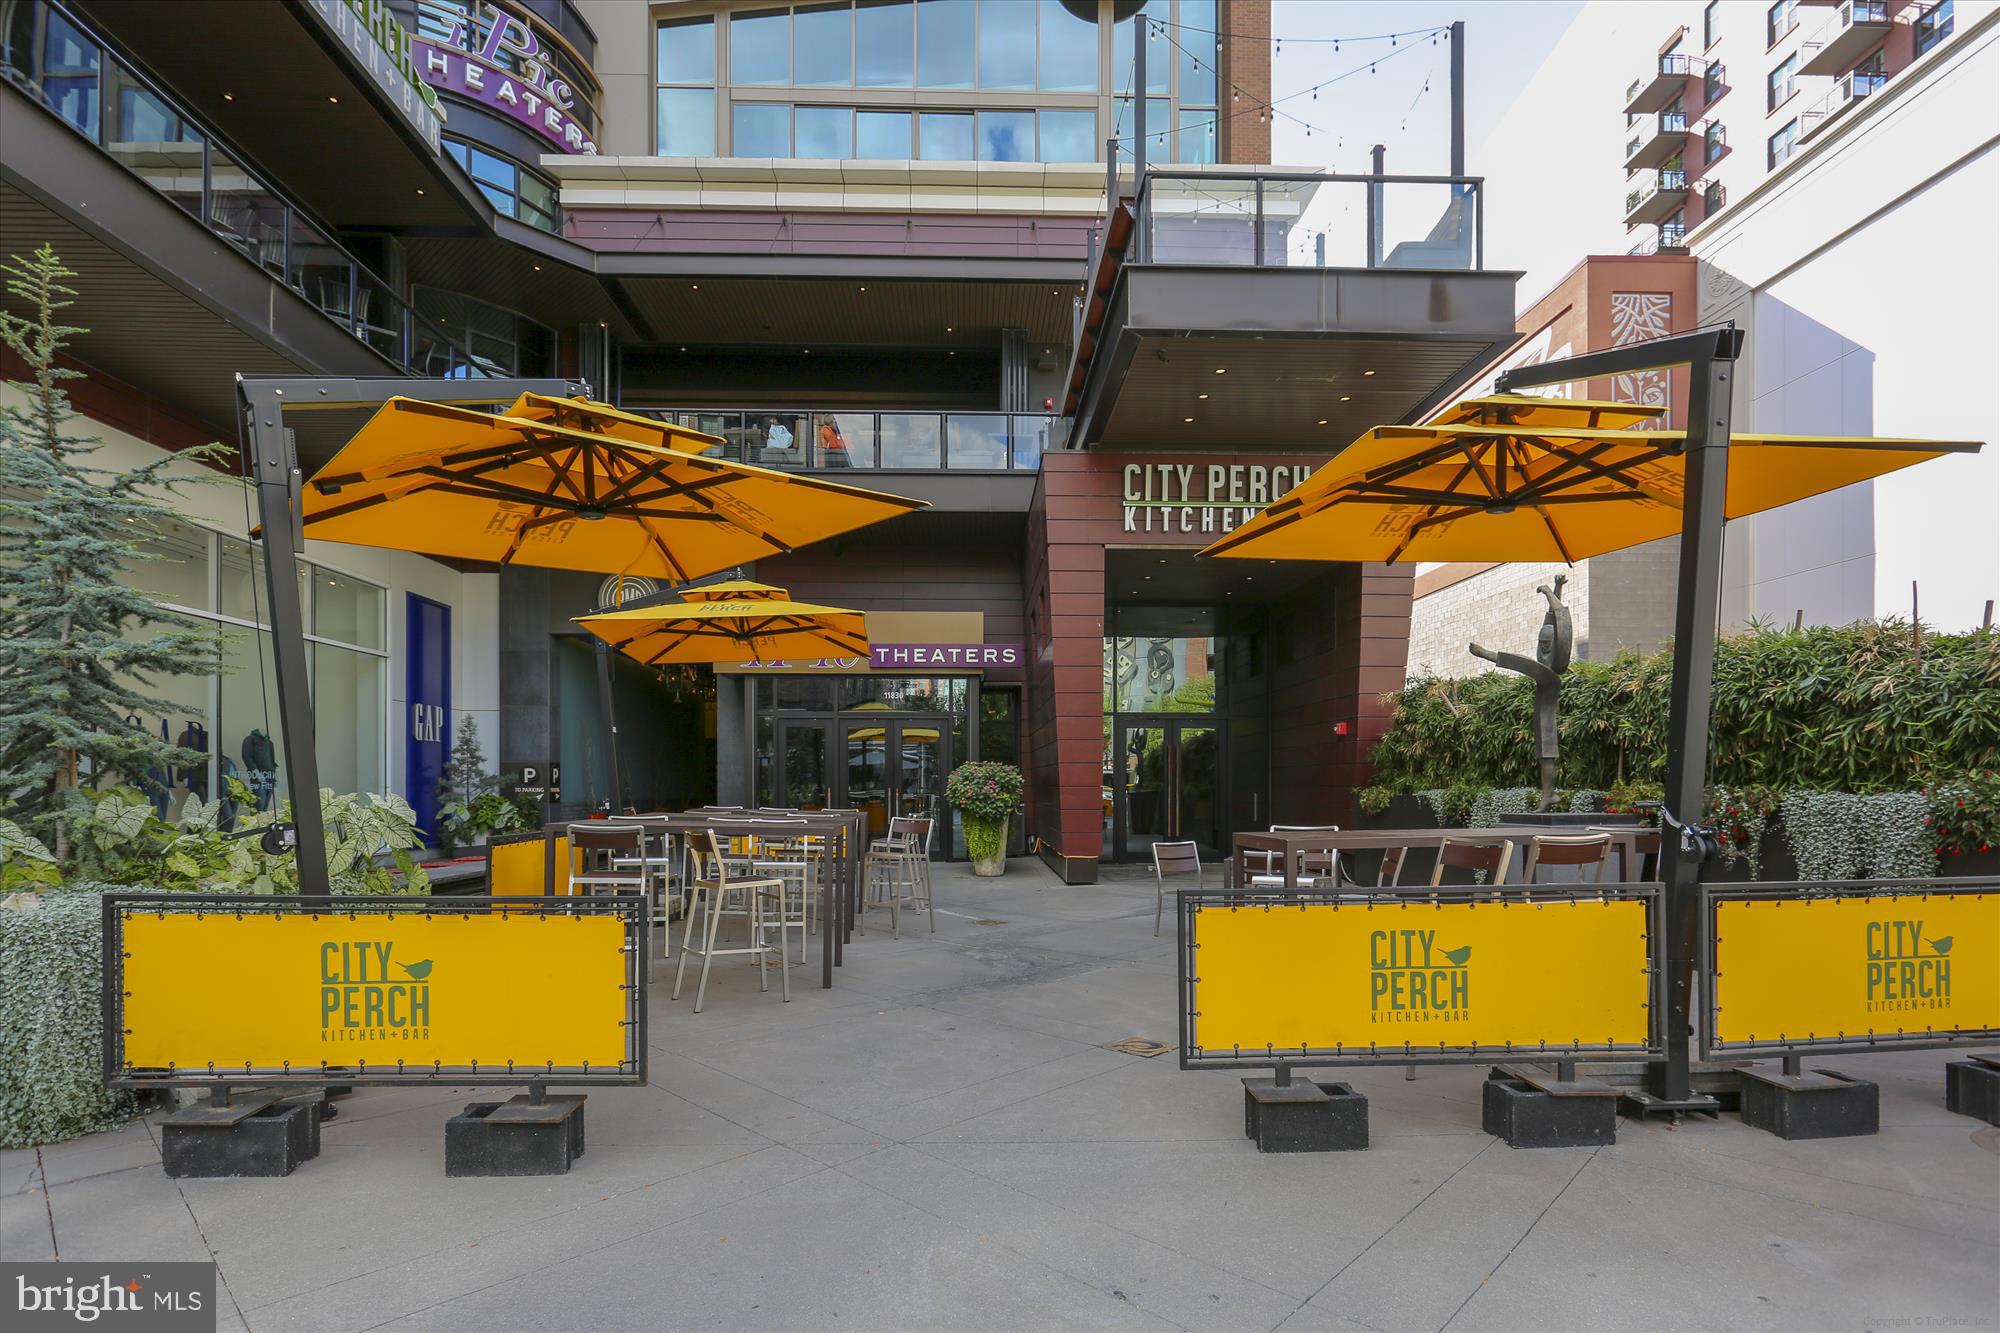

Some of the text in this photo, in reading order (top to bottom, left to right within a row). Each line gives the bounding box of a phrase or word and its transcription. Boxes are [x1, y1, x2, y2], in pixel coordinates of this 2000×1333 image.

[427, 48, 598, 156] HEATERS
[1124, 464, 1311, 502] CITY PERCH
[1124, 506, 1256, 532] KITCHEN
[875, 648, 1017, 663] THEATERS
[884, 691, 904, 699] 11830
[414, 702, 444, 743] GAP
[523, 767, 537, 783] P
[552, 768, 559, 783] P
[1371, 930, 1435, 969] CITY
[1867, 920, 1923, 960] CITY
[321, 941, 393, 983] CITY
[1867, 960, 1950, 1000] PERCH
[321, 986, 429, 1028] PERCH
[1371, 970, 1468, 1010] PERCH
